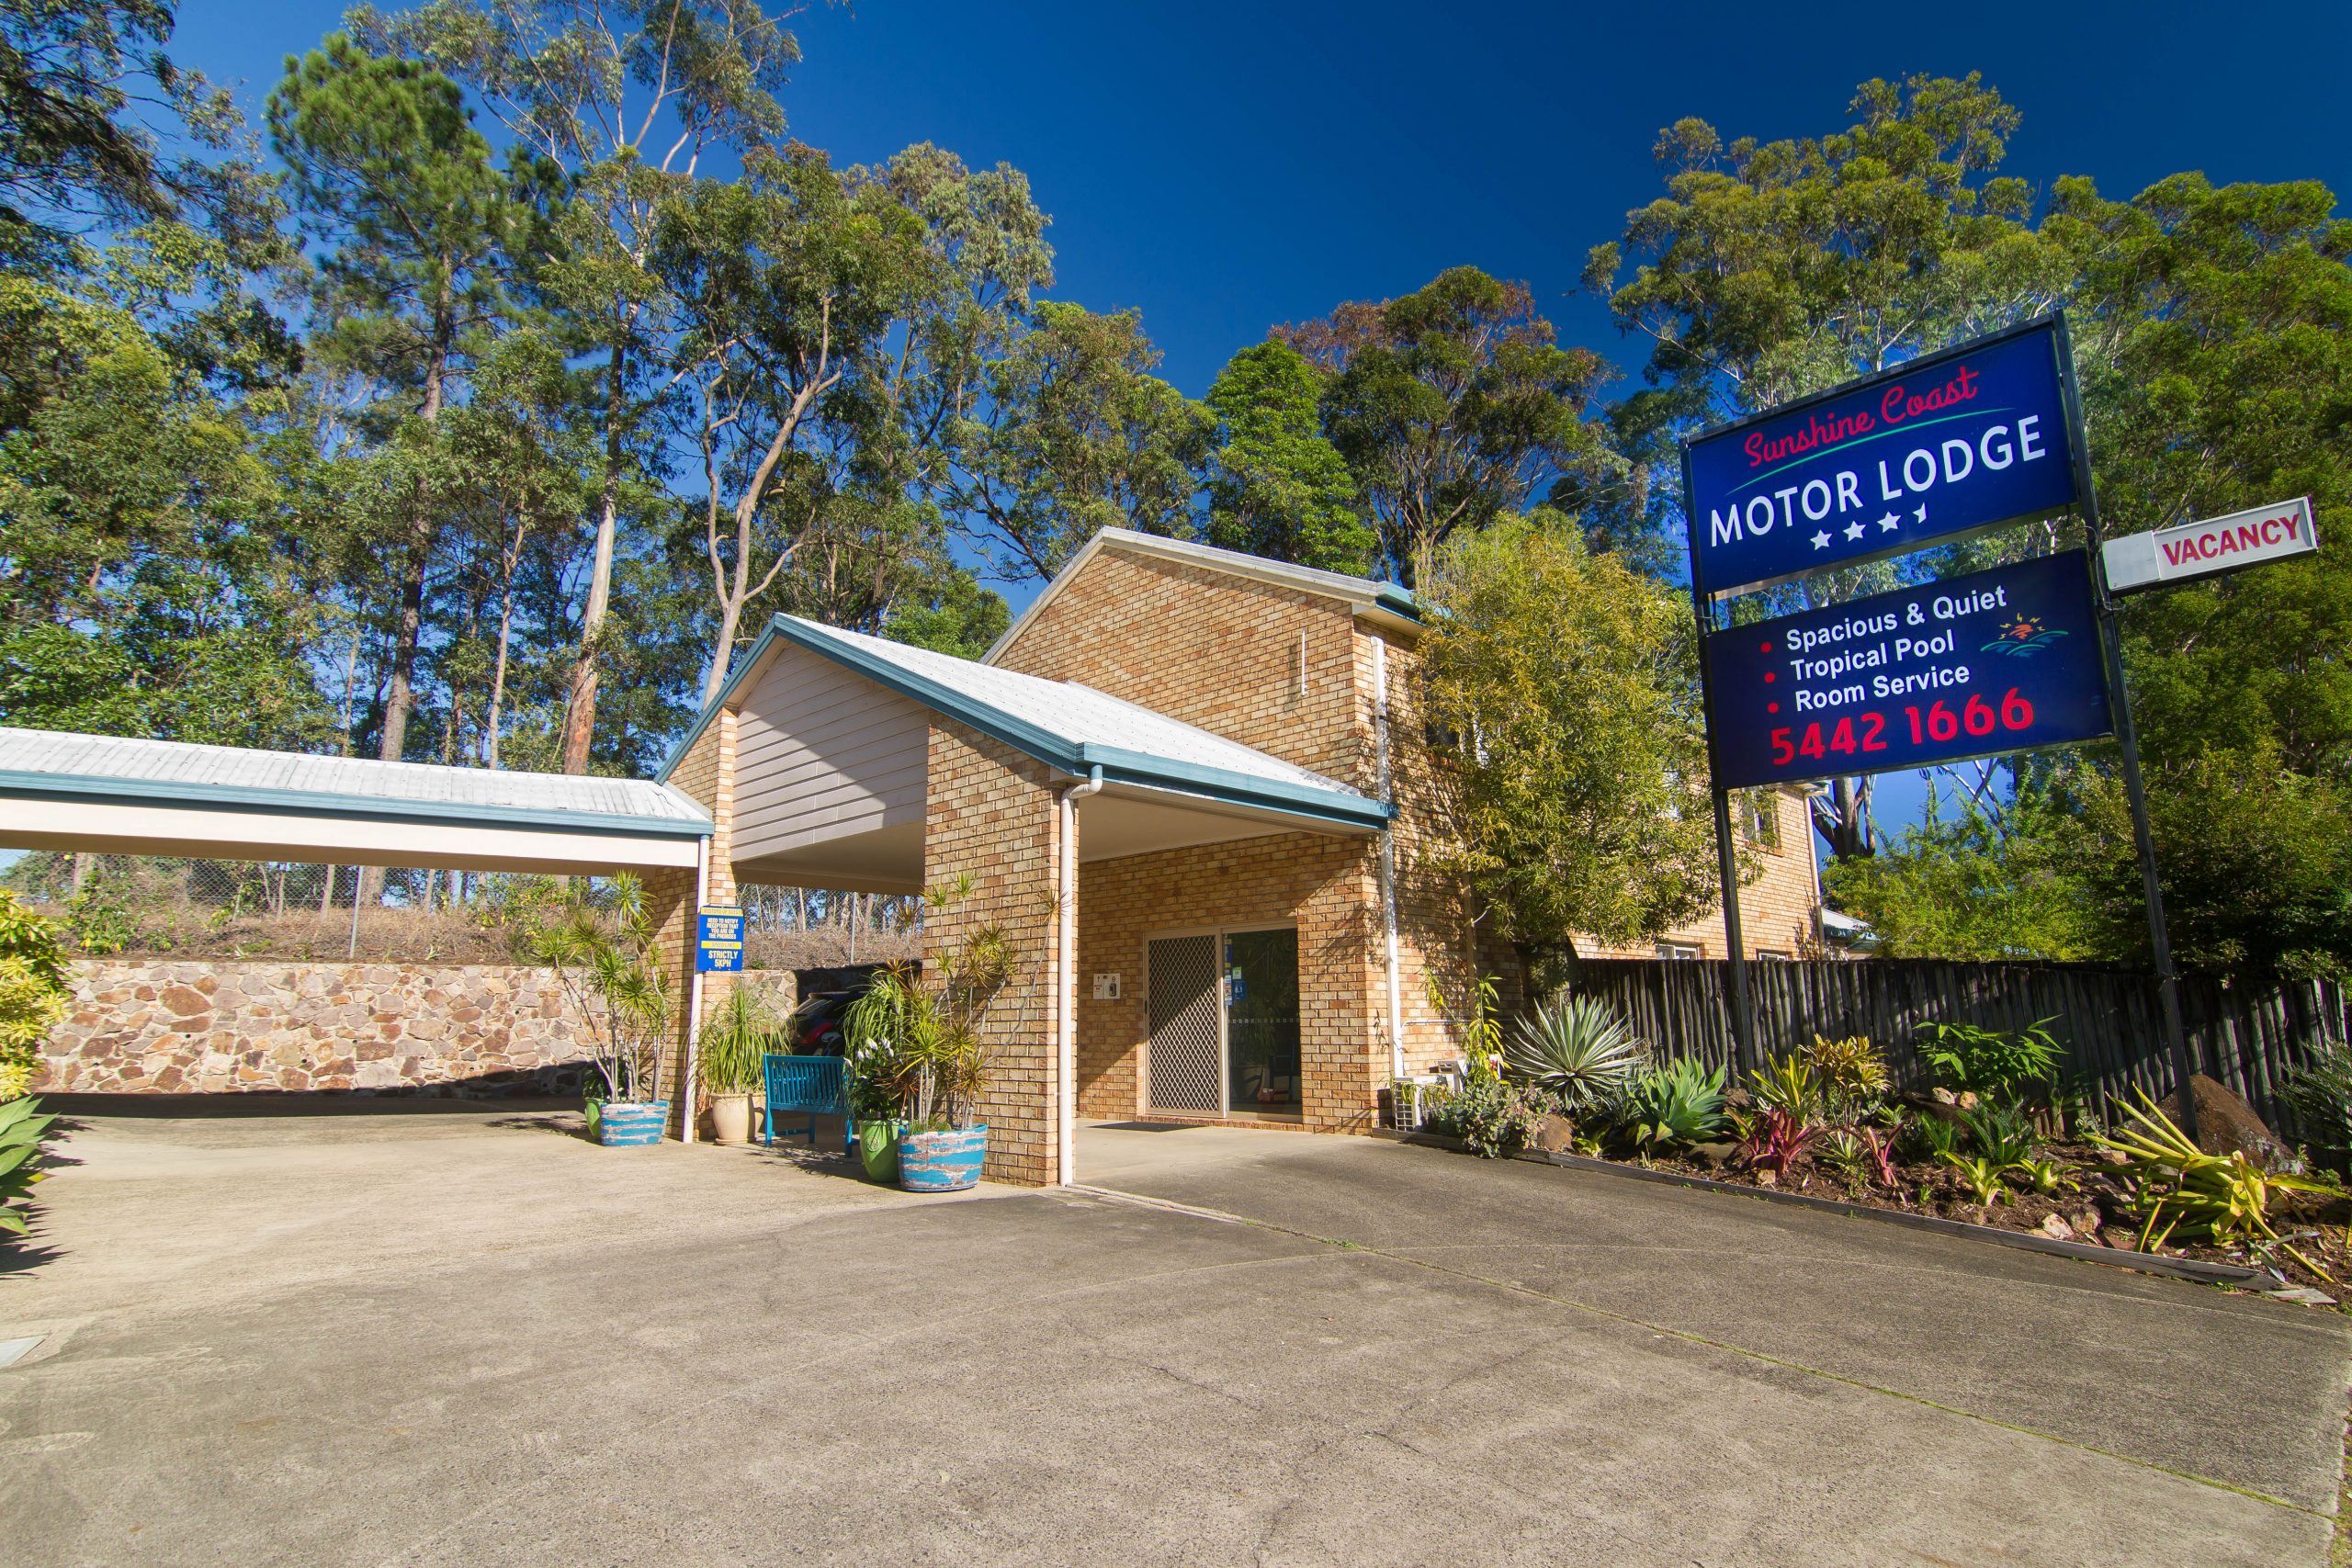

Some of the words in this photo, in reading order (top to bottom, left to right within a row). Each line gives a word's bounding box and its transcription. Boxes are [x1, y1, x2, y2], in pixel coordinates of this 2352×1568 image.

[1745, 412, 1875, 467] Sunshine
[1881, 366, 1980, 423] Coast
[1711, 470, 1863, 547] MOTOR
[1879, 414, 2047, 502] LODGE
[2163, 513, 2301, 566] VACANCY
[1786, 612, 1897, 654] Spacious
[1906, 604, 1926, 626] &
[1933, 584, 2007, 623] Quiet
[1790, 642, 1888, 682] Tropical
[1895, 628, 1955, 661] Pool
[1795, 684, 1866, 712] Room
[1873, 666, 1971, 698] Service
[1771, 713, 1888, 765] 5442
[1905, 687, 2035, 745] 1666
[708, 950, 738, 959] STRICTLY
